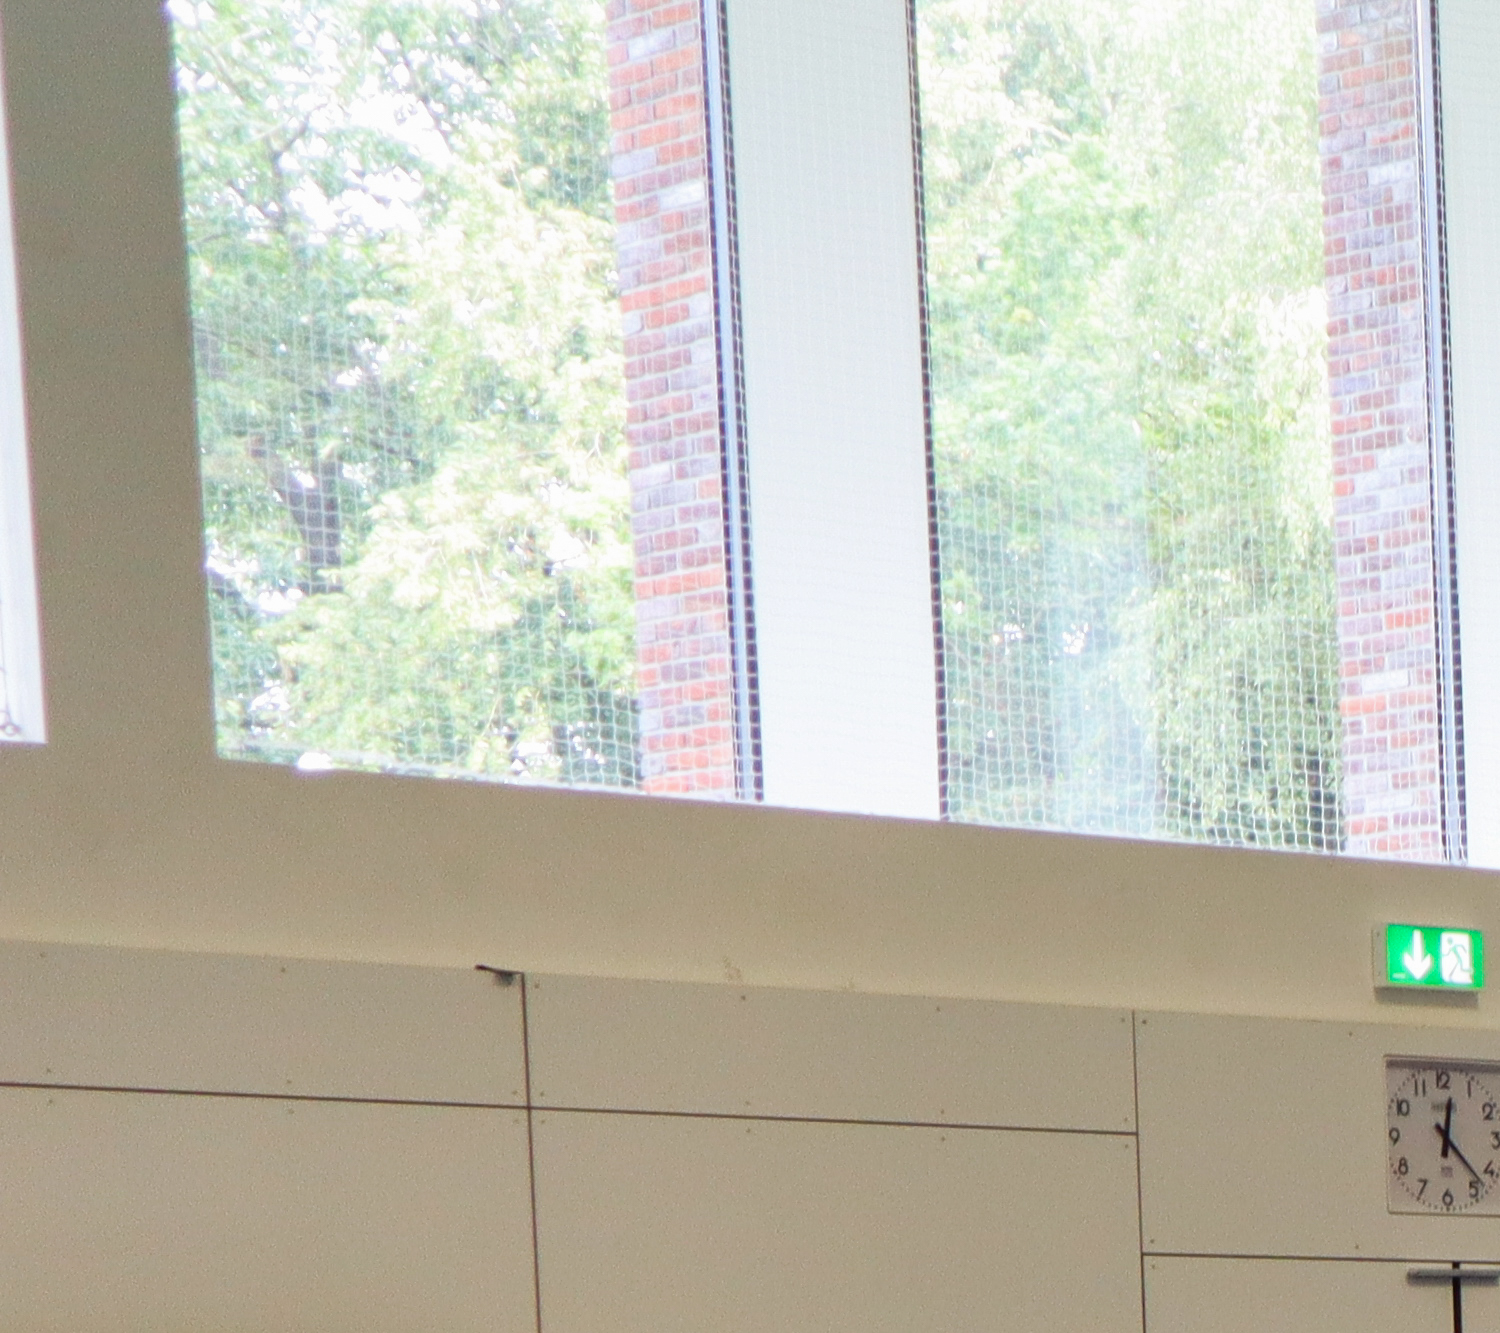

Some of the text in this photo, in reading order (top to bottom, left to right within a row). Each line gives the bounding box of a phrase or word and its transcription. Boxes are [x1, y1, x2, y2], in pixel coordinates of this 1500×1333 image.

[1414, 1078, 1426, 1097] 11
[1435, 1070, 1450, 1090] 12
[1396, 1099, 1410, 1117] 10
[1482, 1102, 1494, 1120] 2
[1389, 1127, 1400, 1146] 9
[1398, 1157, 1409, 1177] 8
[1483, 1159, 1496, 1177] 4
[1416, 1179, 1428, 1197] 7
[1442, 1188, 1454, 1206] 6
[1469, 1181, 1480, 1198] 5
